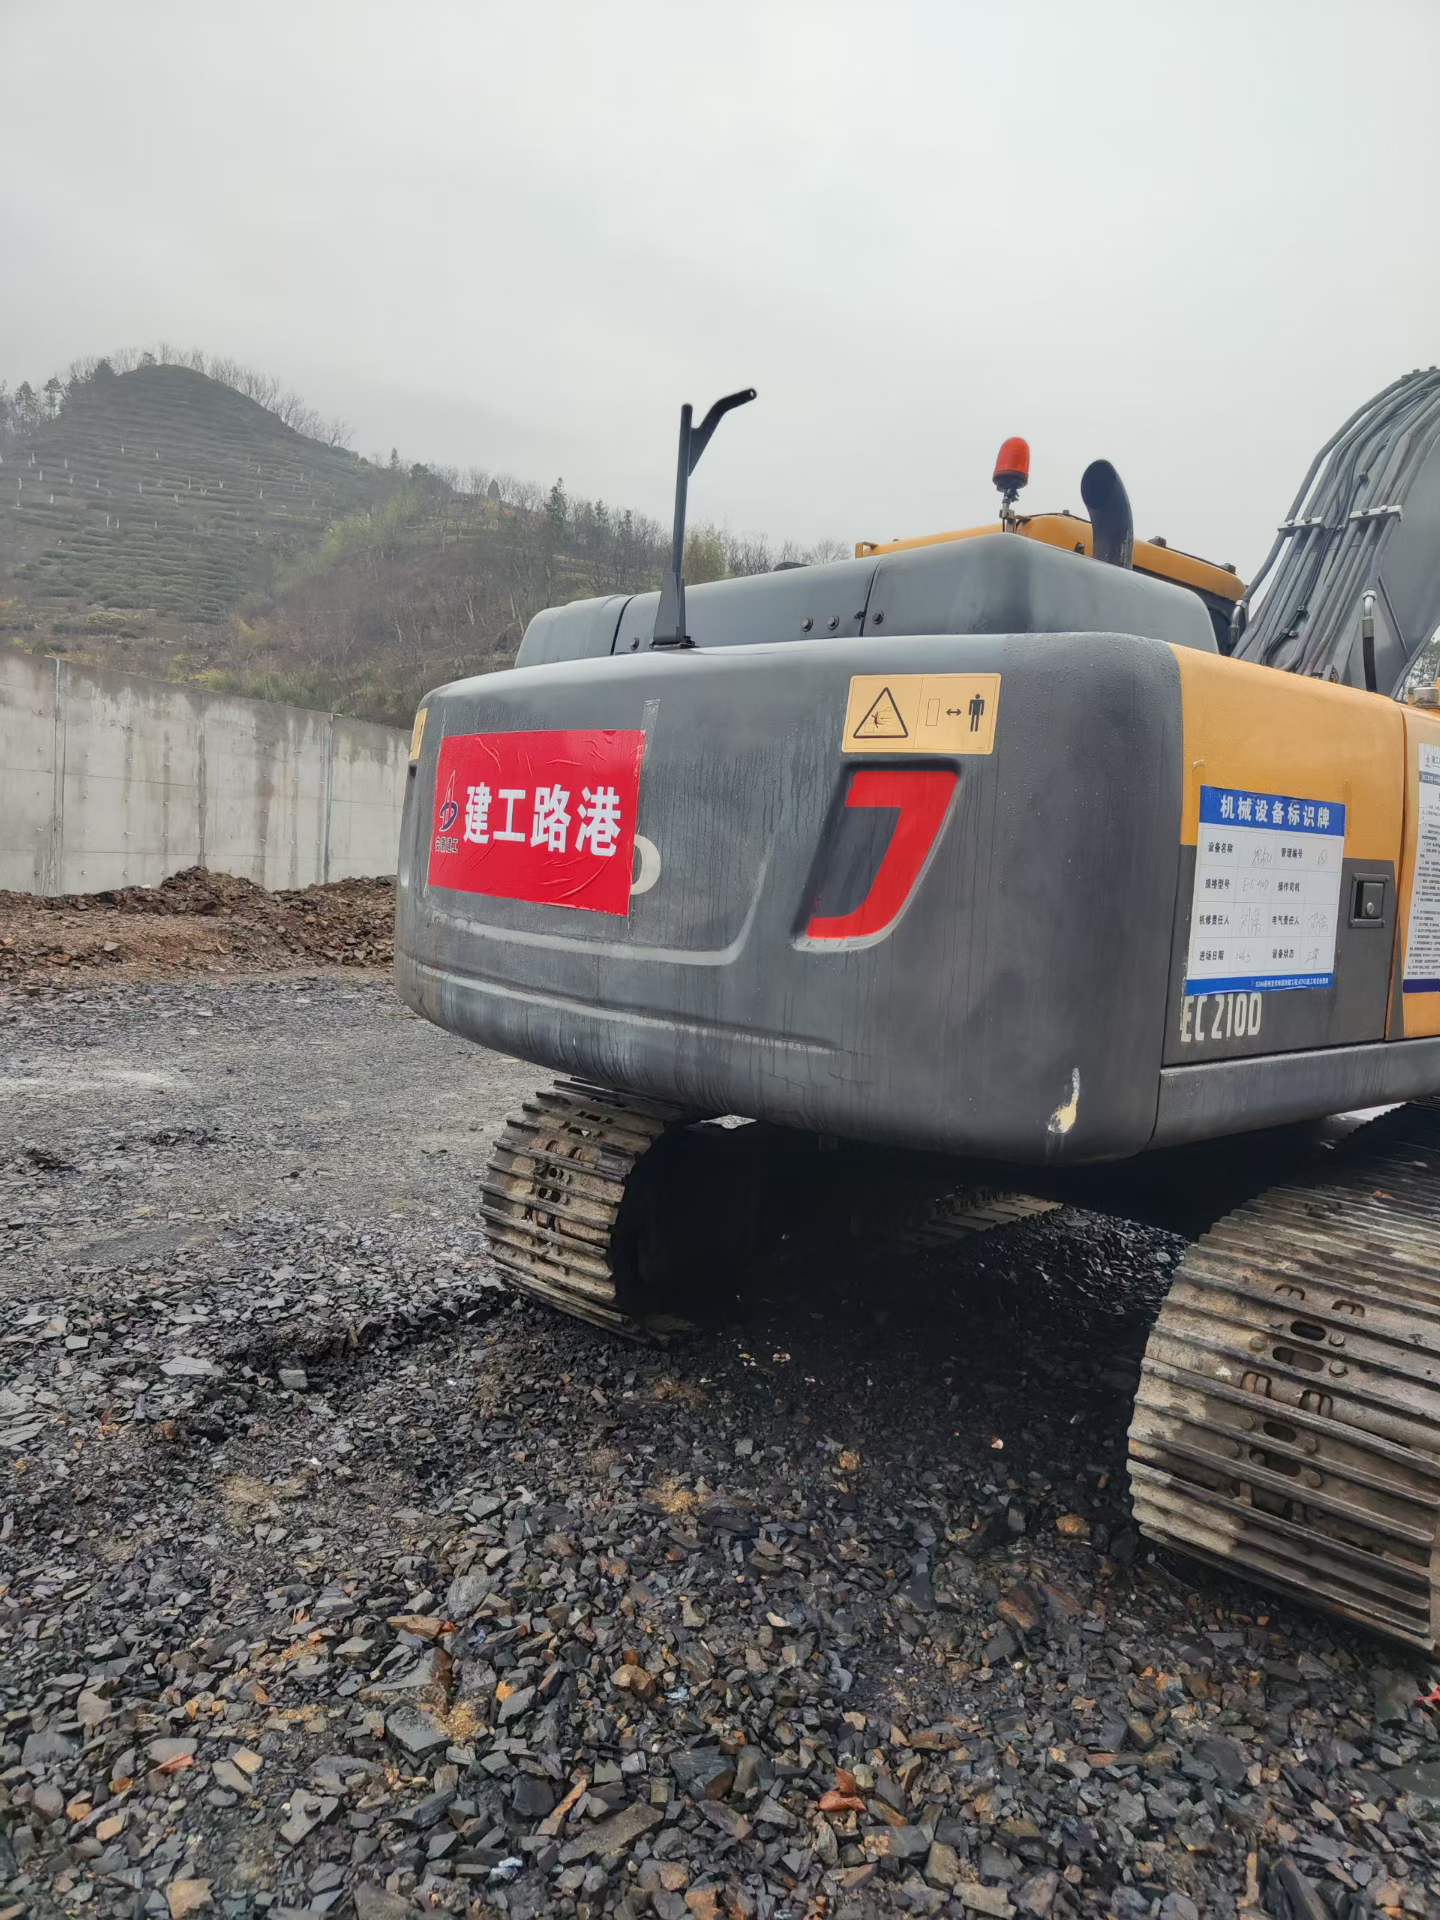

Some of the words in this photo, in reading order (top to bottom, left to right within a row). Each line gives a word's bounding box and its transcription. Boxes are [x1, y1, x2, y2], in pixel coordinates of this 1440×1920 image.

[1220, 794, 1331, 829] 机械设备标识牌
[463, 781, 621, 857] 建工路港
[1208, 841, 1234, 855] 设备名称
[1281, 847, 1303, 860] 管理编号
[1204, 877, 1231, 890] 规格型号
[1277, 880, 1300, 893] 操作司机
[1271, 947, 1295, 960] 设备状态
